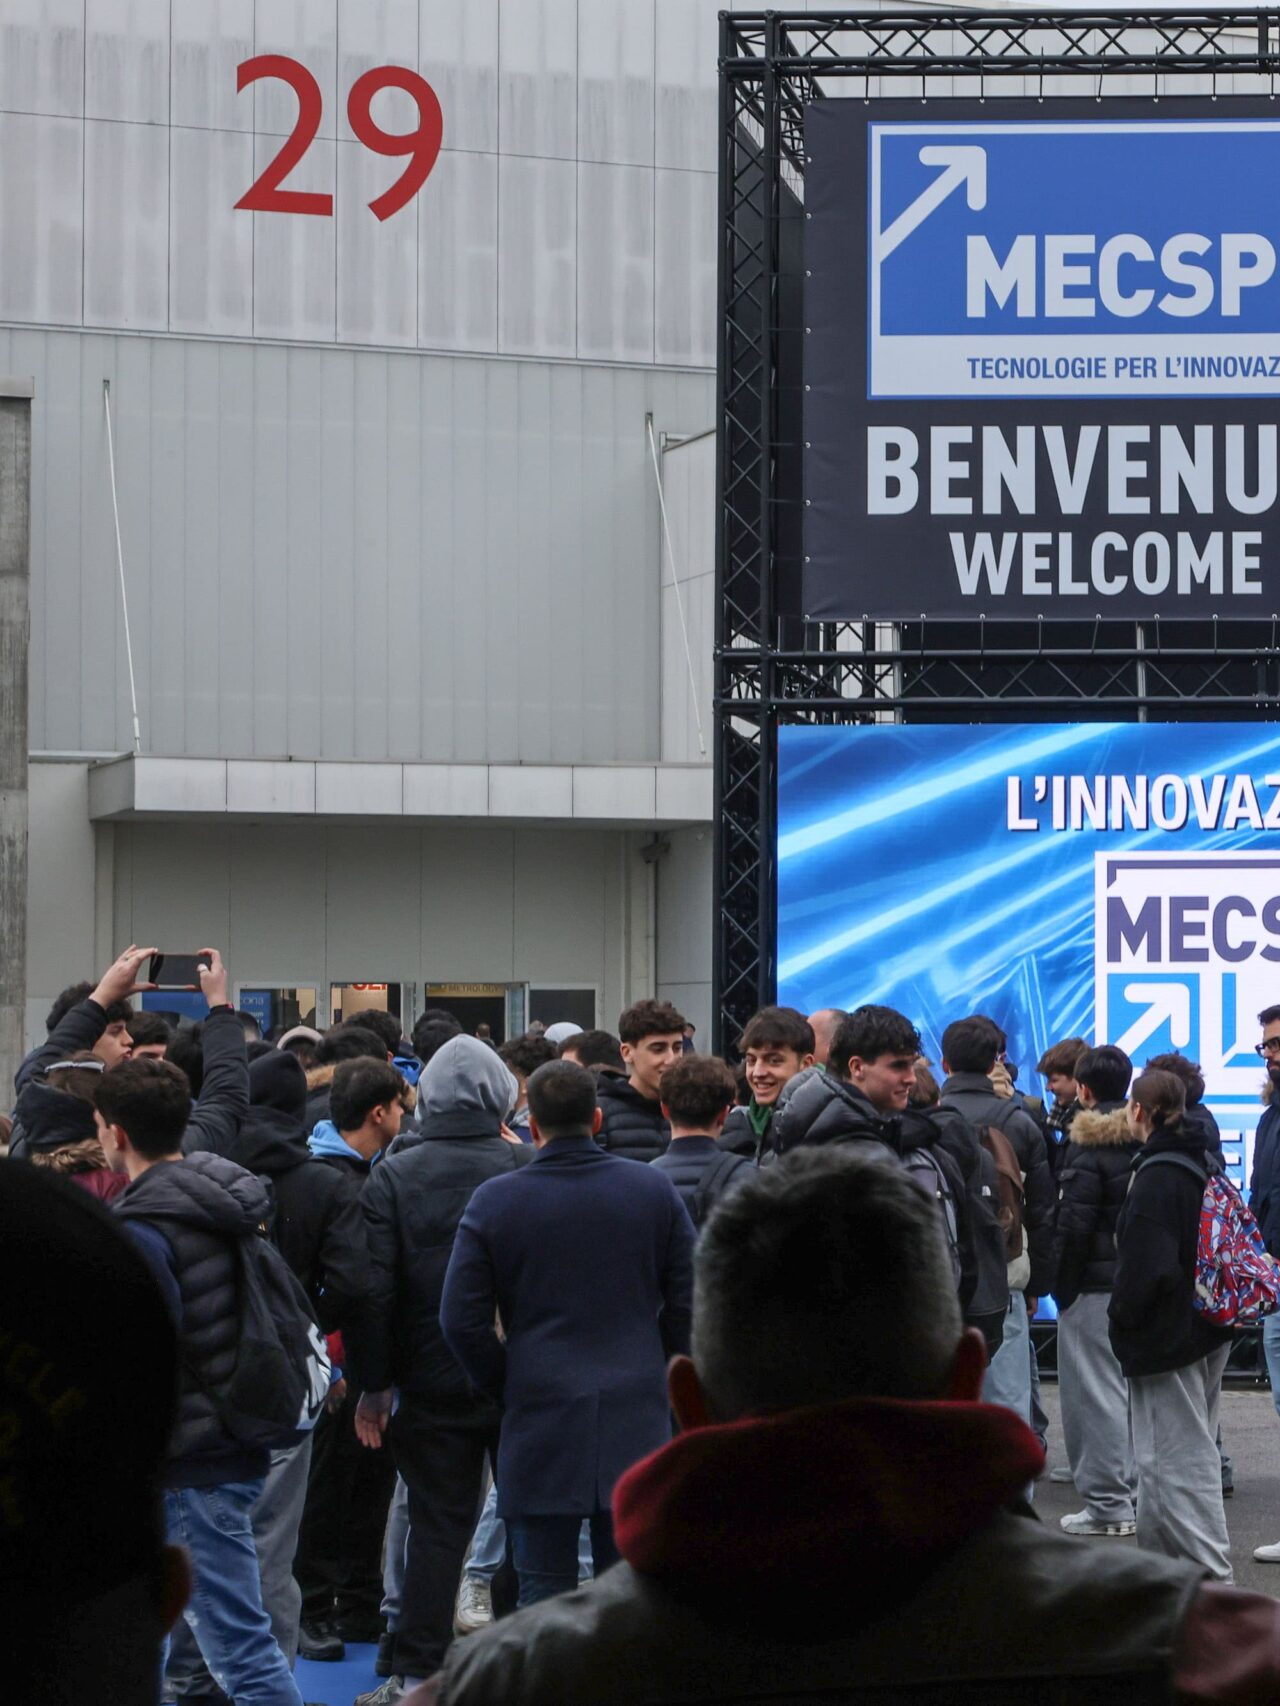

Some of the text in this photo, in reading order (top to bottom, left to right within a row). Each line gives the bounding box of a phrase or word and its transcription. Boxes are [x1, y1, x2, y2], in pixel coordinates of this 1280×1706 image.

[236, 55, 443, 221] 29
[967, 356, 1107, 379] TECNOLOGIE
[1114, 356, 1157, 377] PER
[949, 531, 1263, 596] WELCOME
